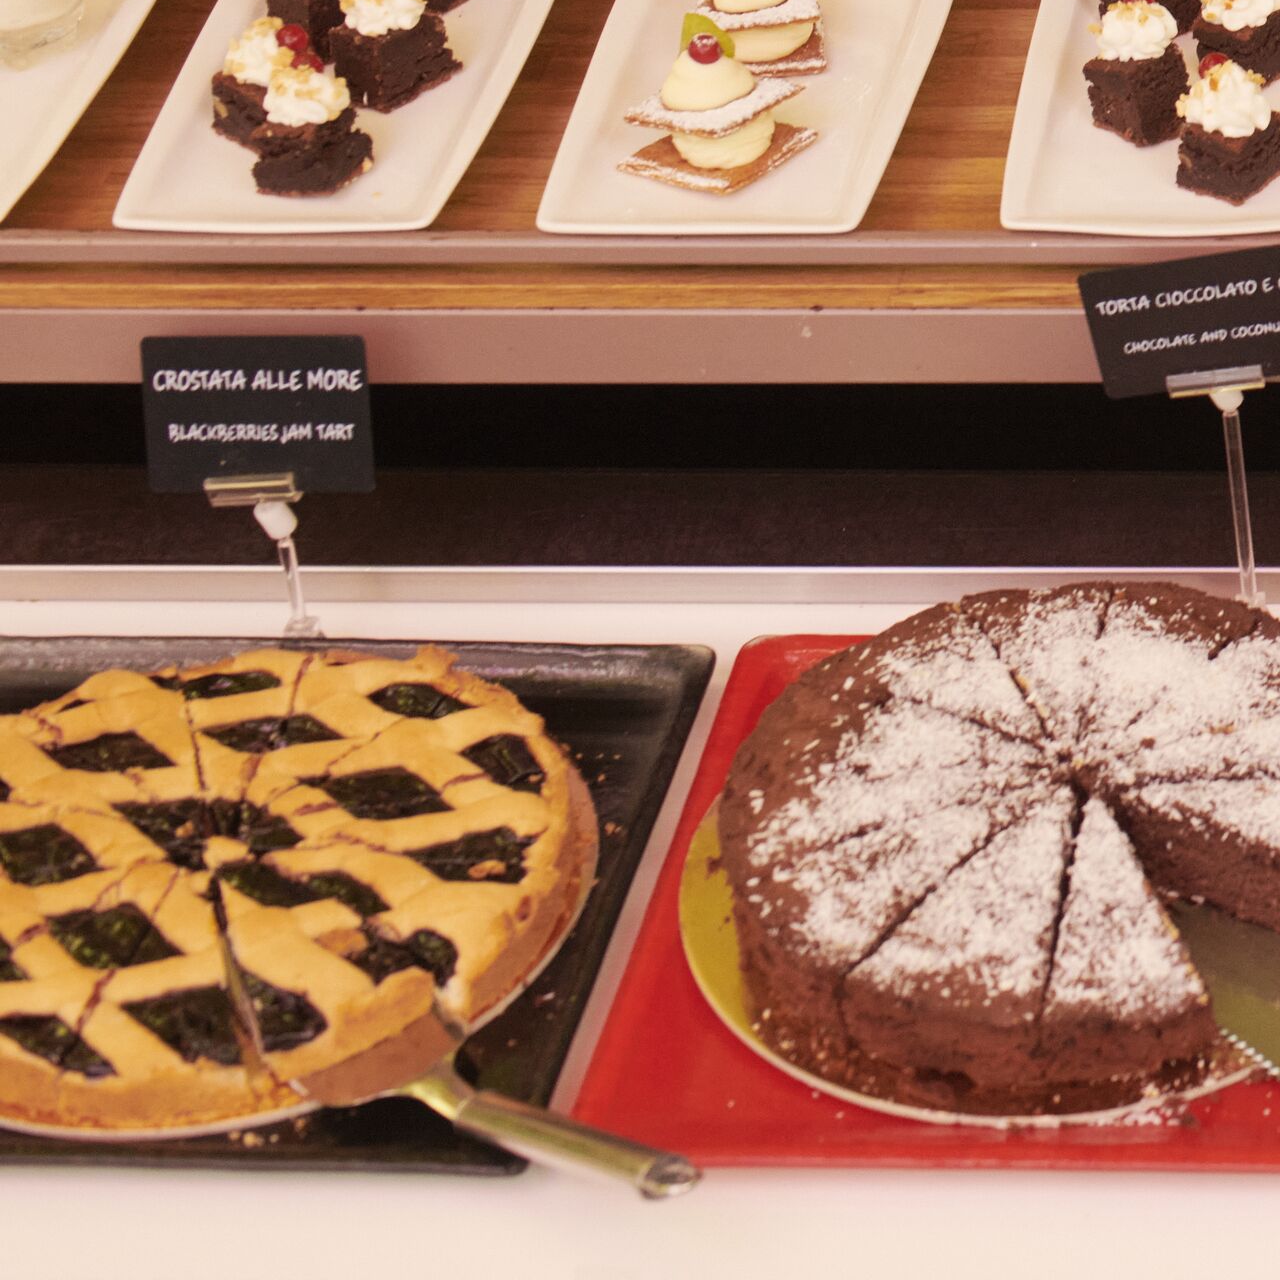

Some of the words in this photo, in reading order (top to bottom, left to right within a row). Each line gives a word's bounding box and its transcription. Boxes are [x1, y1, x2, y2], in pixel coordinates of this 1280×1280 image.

[1096, 295, 1150, 316] TORTA
[1155, 280, 1257, 307] CIOCCOLATO
[1262, 278, 1273, 293] E
[1123, 333, 1197, 355] CHOCOLATE
[1200, 329, 1227, 343] AND
[153, 369, 247, 392] CROSTATA
[251, 369, 302, 391] ALLE
[307, 368, 363, 391] MORE
[168, 424, 278, 443] BLACKBERRIES
[315, 424, 355, 440] TART
